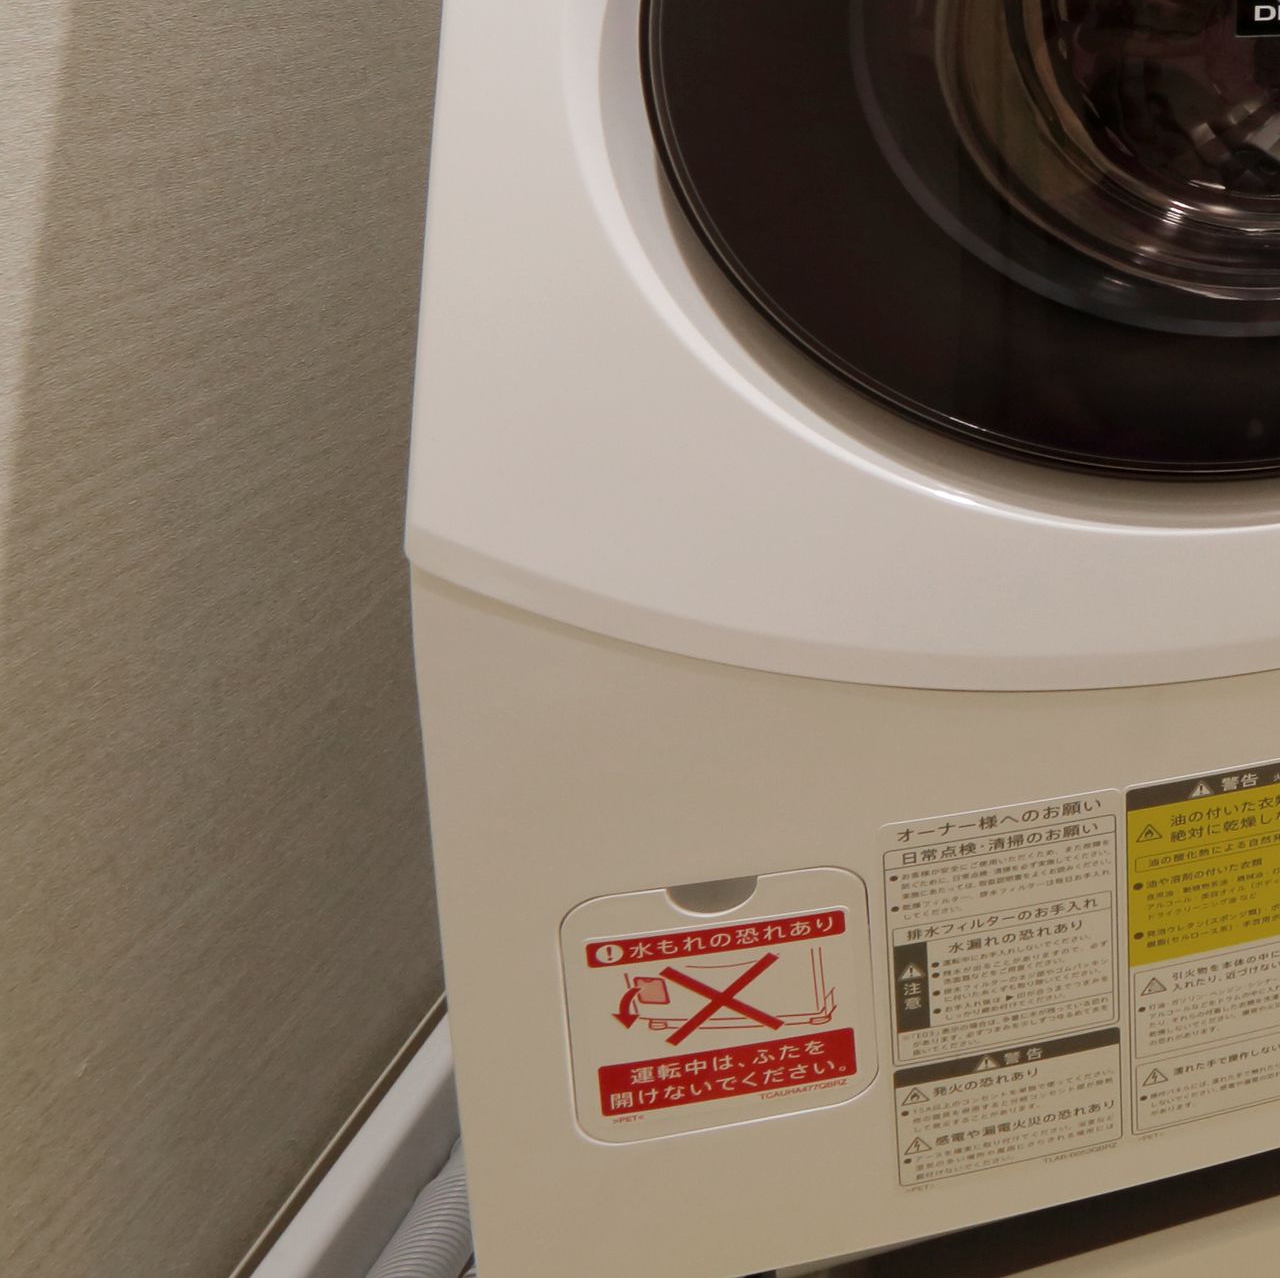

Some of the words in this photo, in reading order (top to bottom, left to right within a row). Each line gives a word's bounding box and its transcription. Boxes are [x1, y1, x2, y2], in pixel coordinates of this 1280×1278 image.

[1221, 773, 1259, 792] 警告
[897, 799, 1101, 843] オーナー様へのお願い
[630, 918, 834, 959] 水もれの恐れあり
[906, 898, 1098, 941] 排水フィルターのお手入れ
[948, 920, 1083, 954] 水漏れの恐れあり
[630, 1039, 825, 1085] 運転中は、ふたを
[1003, 1048, 1043, 1065] 警告
[610, 1063, 848, 1110] 開けないでください。
[933, 1068, 1038, 1098] 発火の恐れあり
[935, 1100, 1114, 1146] 感電や漏電火災の恐れあり
